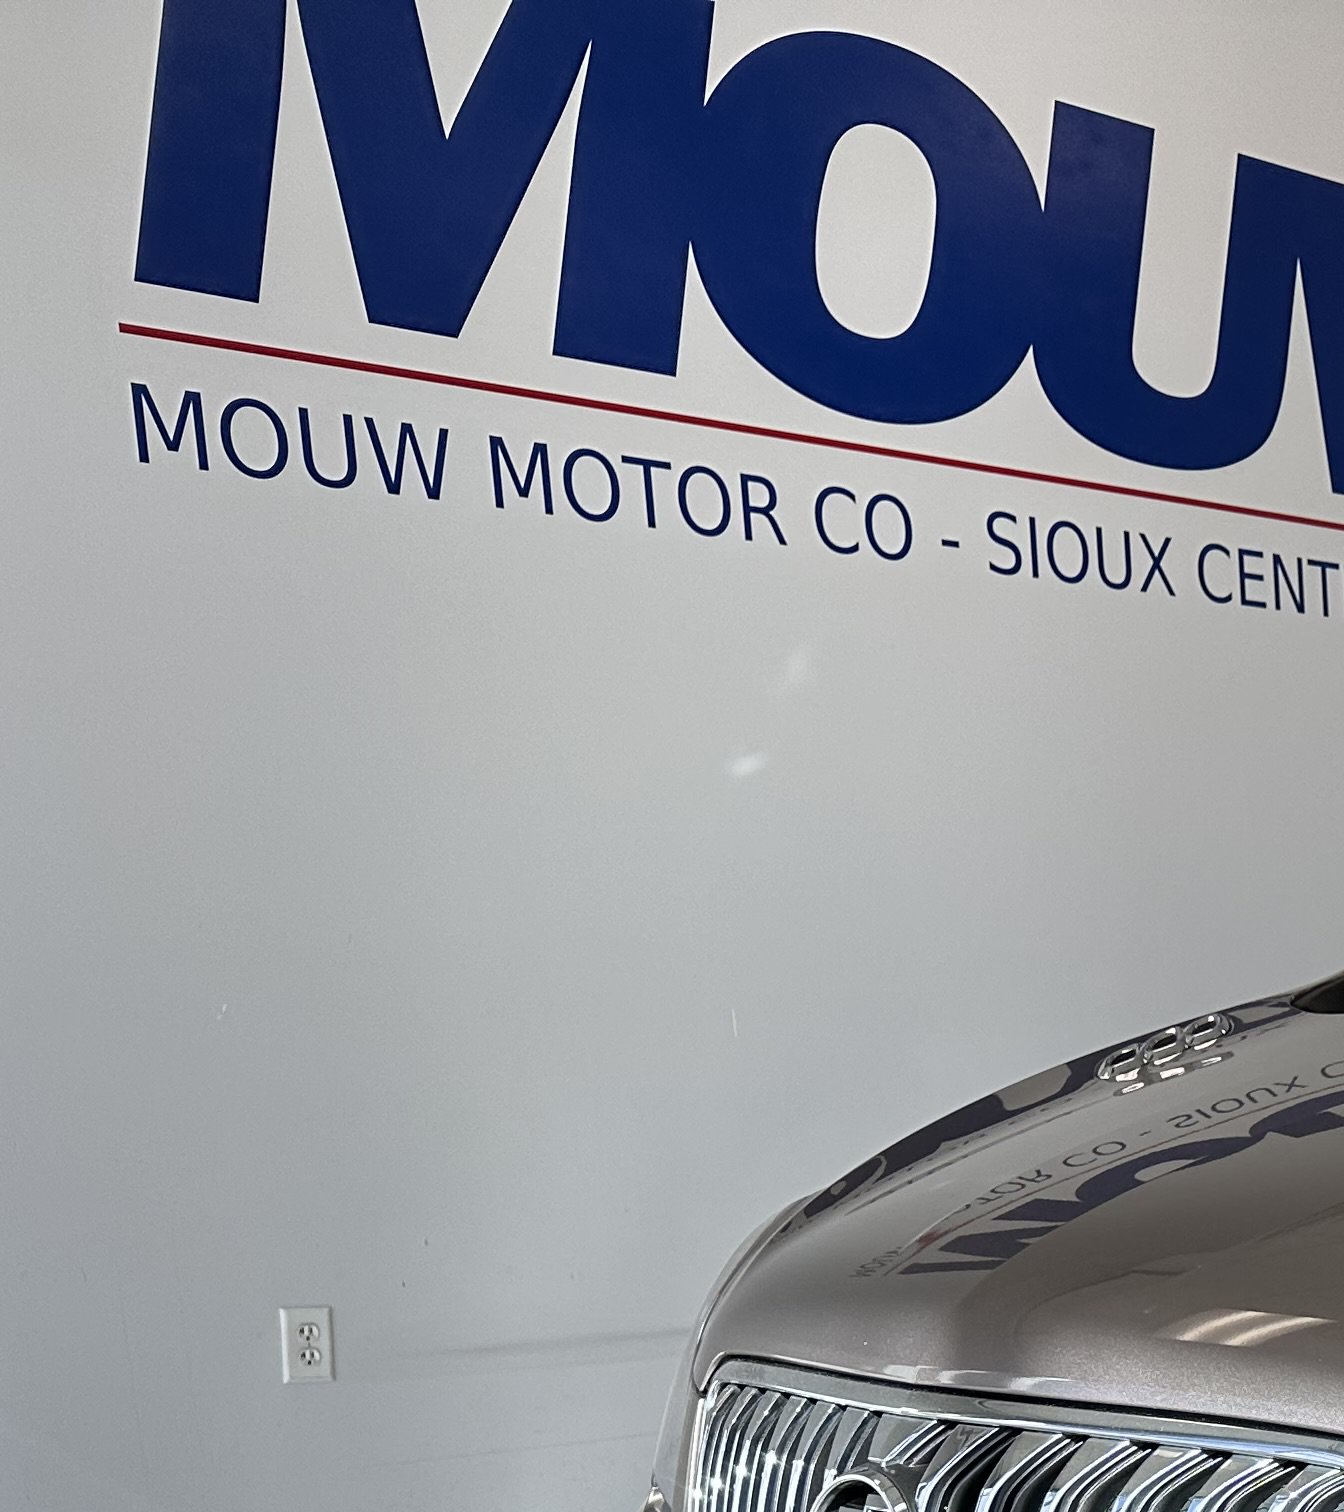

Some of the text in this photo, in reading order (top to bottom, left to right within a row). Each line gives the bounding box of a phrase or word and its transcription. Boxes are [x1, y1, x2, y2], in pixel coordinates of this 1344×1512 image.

[130, 382, 449, 501] MOUW
[488, 434, 788, 546] MOTOR
[814, 486, 913, 561] CO
[986, 510, 1176, 597] SIOUX
